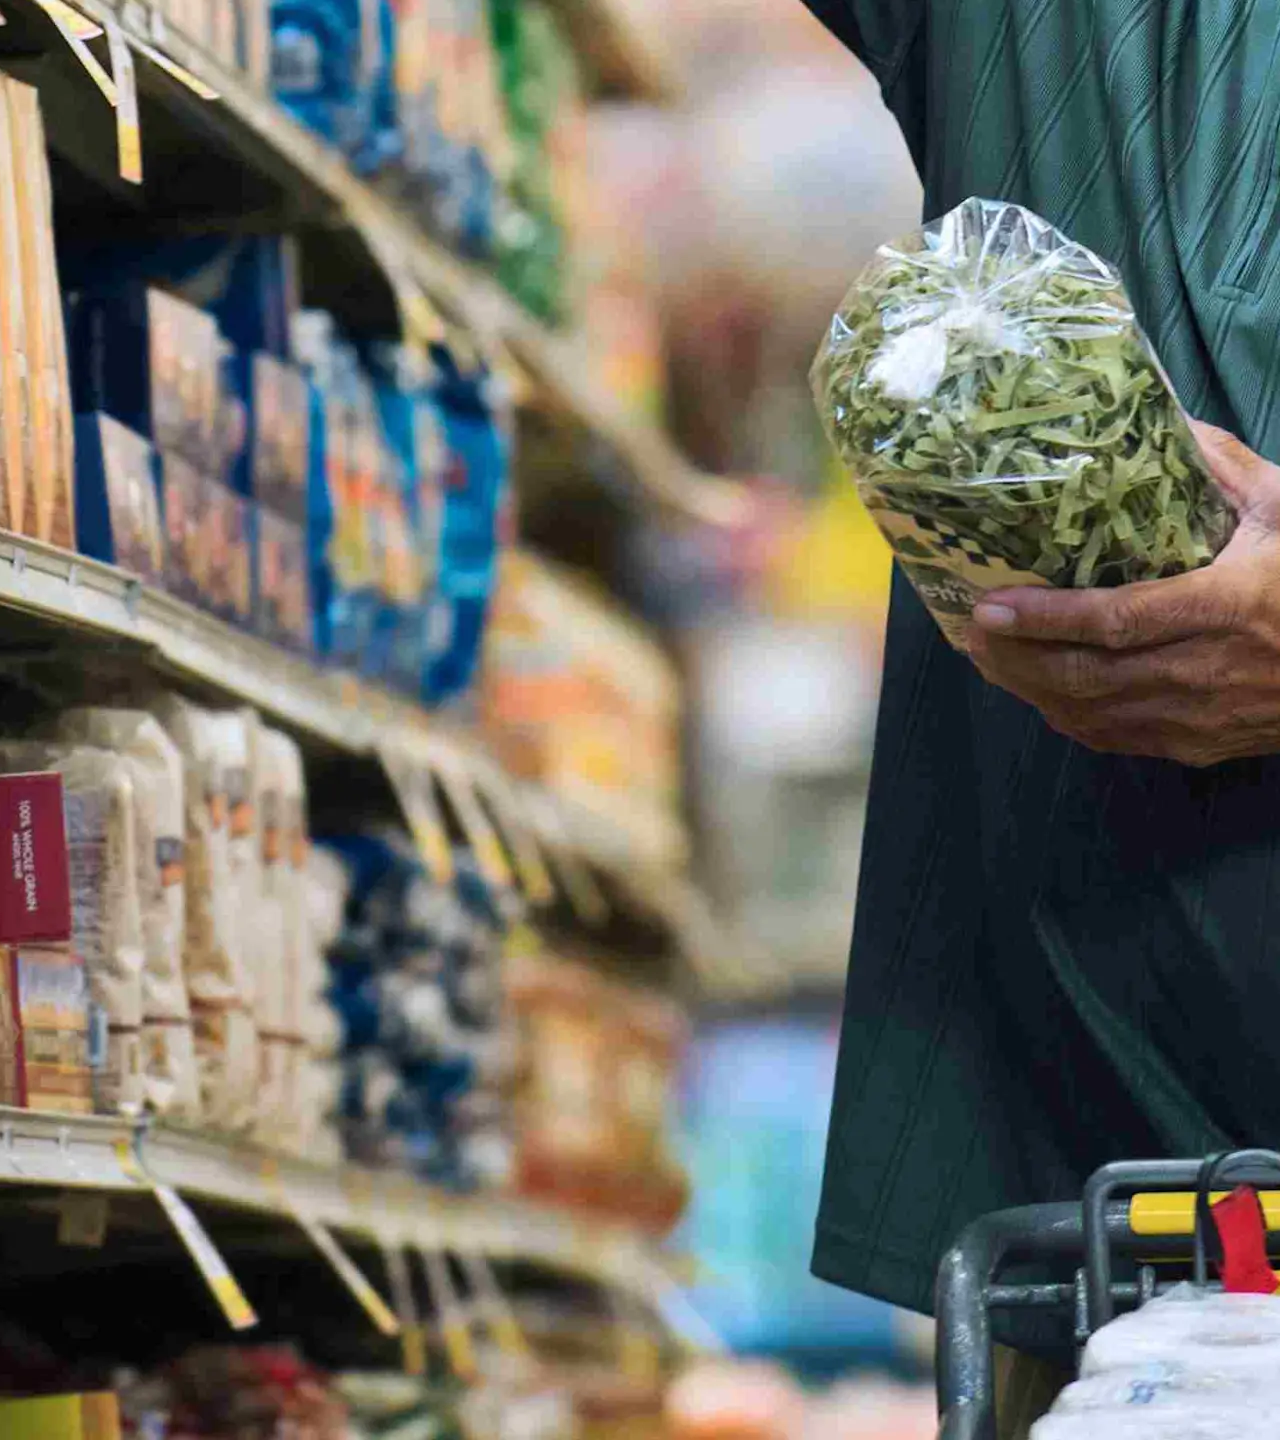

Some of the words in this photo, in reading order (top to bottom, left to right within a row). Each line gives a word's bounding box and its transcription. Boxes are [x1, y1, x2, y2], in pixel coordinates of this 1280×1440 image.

[19, 799, 31, 828] 100%
[22, 829, 35, 871] WHOLE
[24, 873, 39, 912] GRAIN
